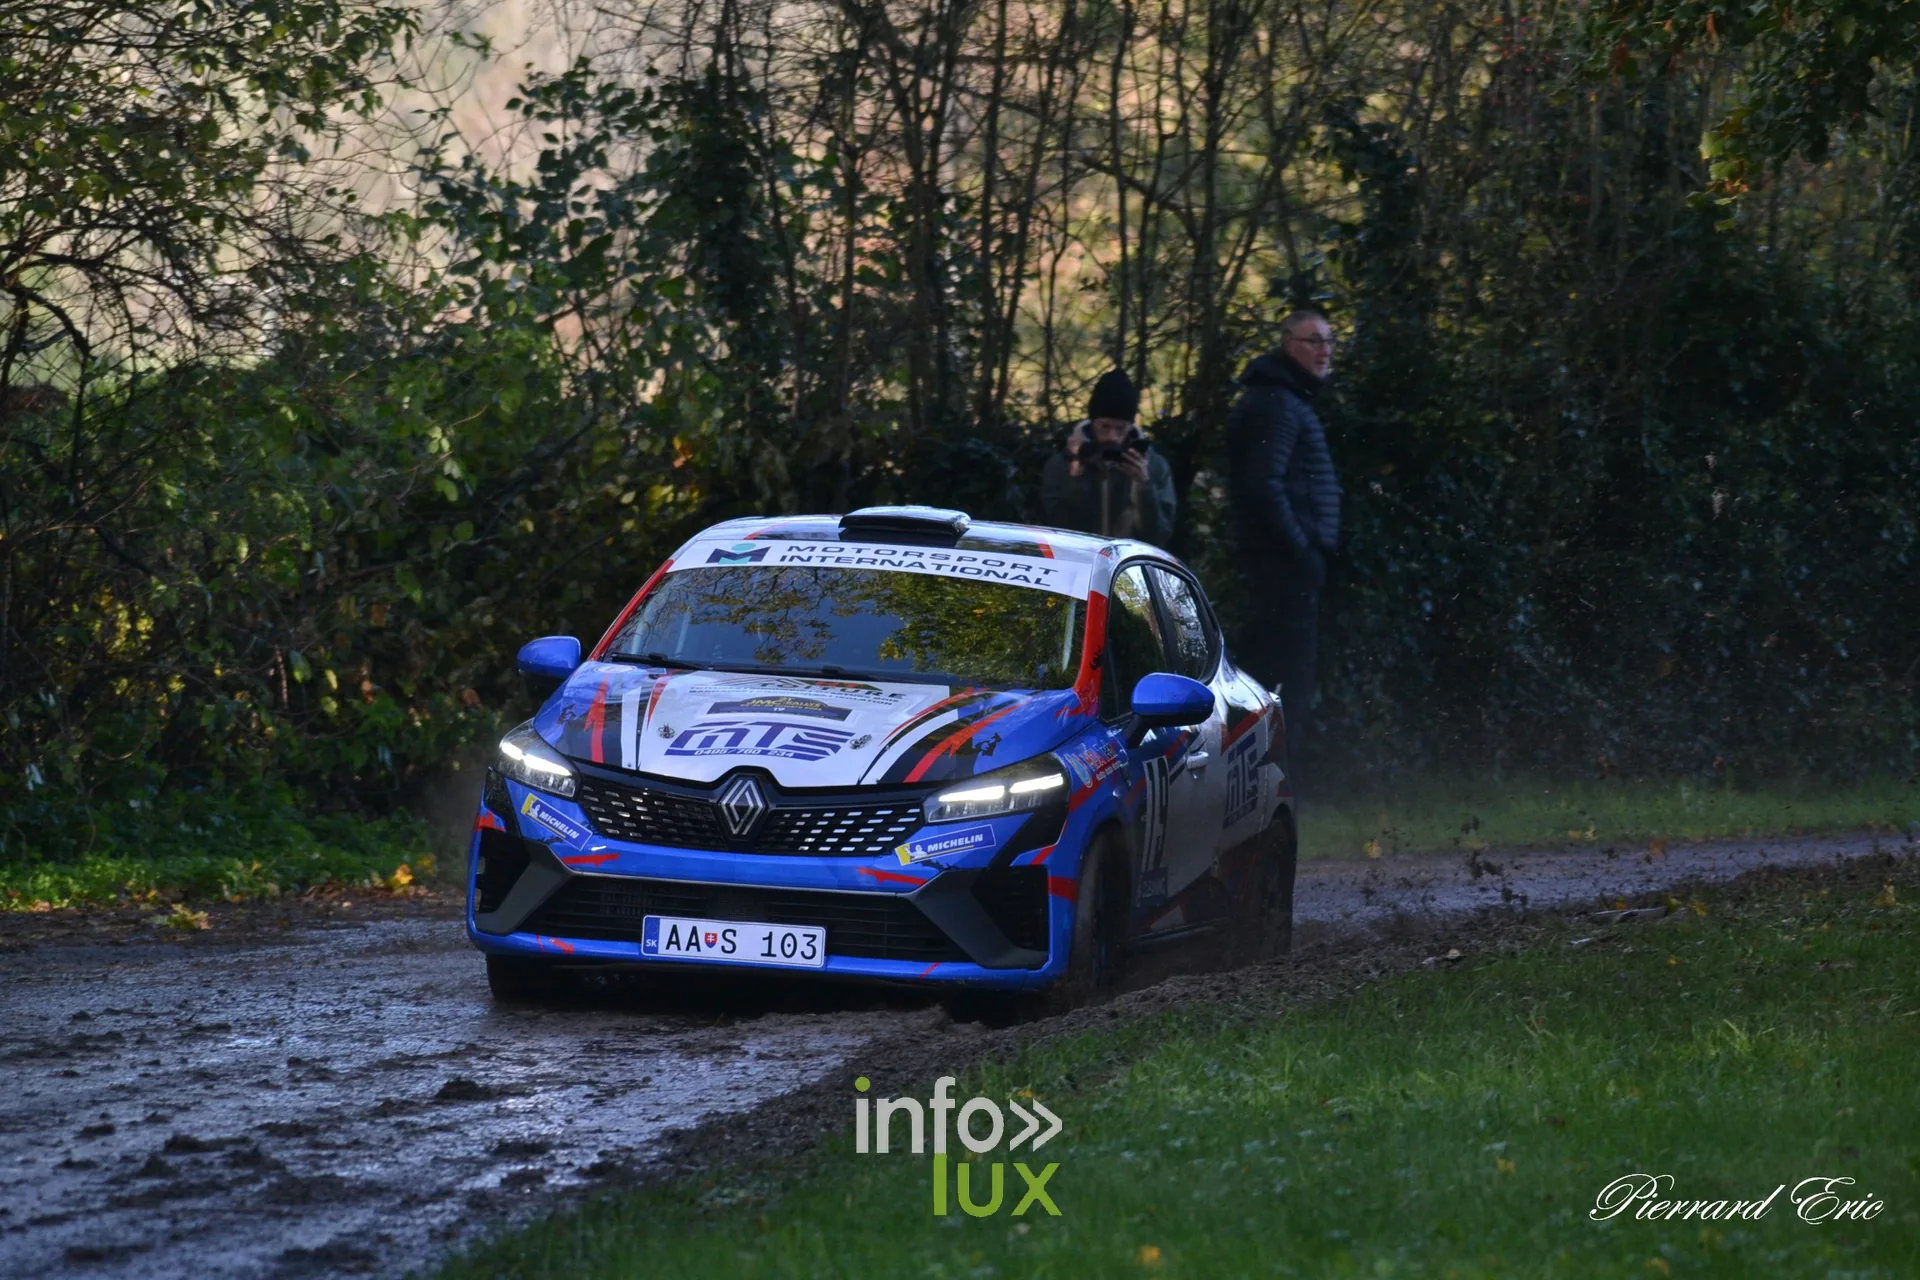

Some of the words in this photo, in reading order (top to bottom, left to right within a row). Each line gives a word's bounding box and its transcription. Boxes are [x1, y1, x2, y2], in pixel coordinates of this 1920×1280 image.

[779, 555, 1051, 587] INTERNATIONAL
[787, 545, 1059, 575] MOTORSPORT
[539, 811, 580, 839] MICHELIN
[927, 834, 983, 853] MICHELIN
[646, 939, 657, 948] SK
[665, 924, 702, 952] AA
[720, 928, 738, 954] S
[760, 931, 818, 960] 103
